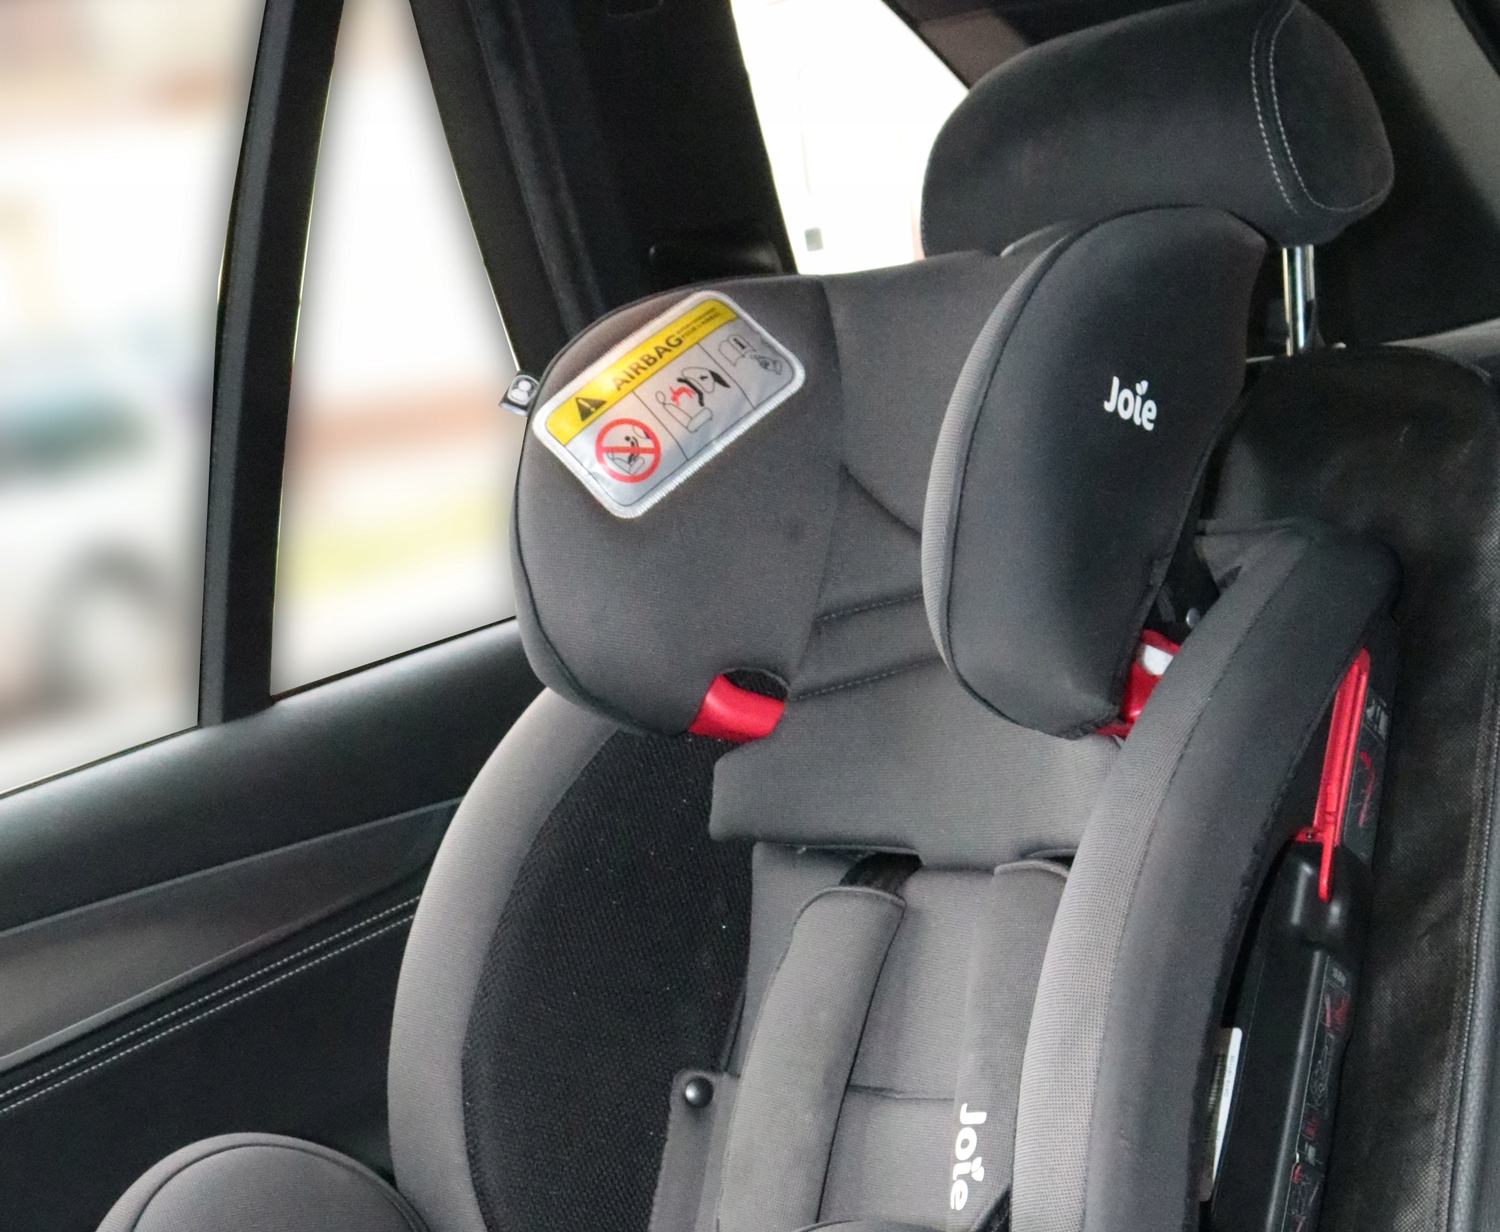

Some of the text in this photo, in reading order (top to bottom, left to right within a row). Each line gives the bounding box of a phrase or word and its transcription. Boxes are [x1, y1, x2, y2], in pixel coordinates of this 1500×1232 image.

[612, 334, 683, 391] AIRBAG
[1103, 375, 1157, 431] Joie
[950, 1103, 987, 1210] Joie
